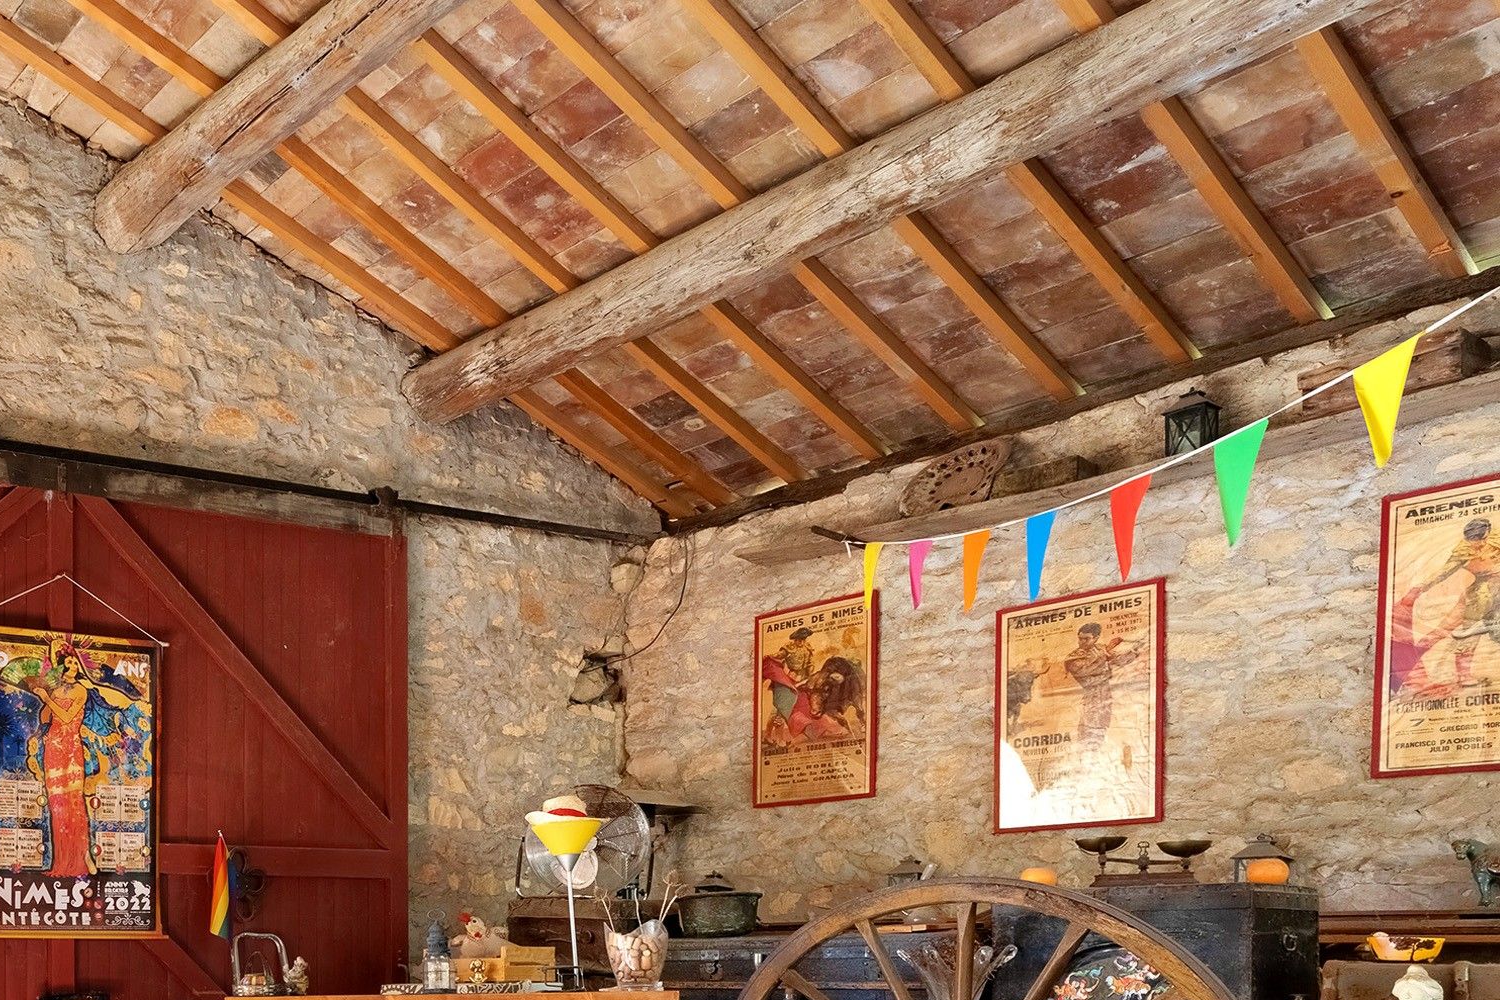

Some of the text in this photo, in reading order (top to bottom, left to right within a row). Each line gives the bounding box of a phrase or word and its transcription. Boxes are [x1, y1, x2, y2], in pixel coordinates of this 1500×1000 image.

[1405, 494, 1495, 519] ARENES
[1414, 513, 1454, 526] DIMANCHE
[766, 605, 864, 633] ARENES DE NIMES
[1014, 597, 1143, 630] ARENES DE NIMES
[114, 661, 151, 678] ANS
[1439, 724, 1478, 733] GREGORIO
[1013, 732, 1072, 749] CORRIDA
[1395, 736, 1485, 749] FRANCISCO PAQUIRRI
[1429, 742, 1493, 753] JULIO ROBLES
[806, 760, 848, 770] ROBLES
[104, 897, 151, 911] 2022
